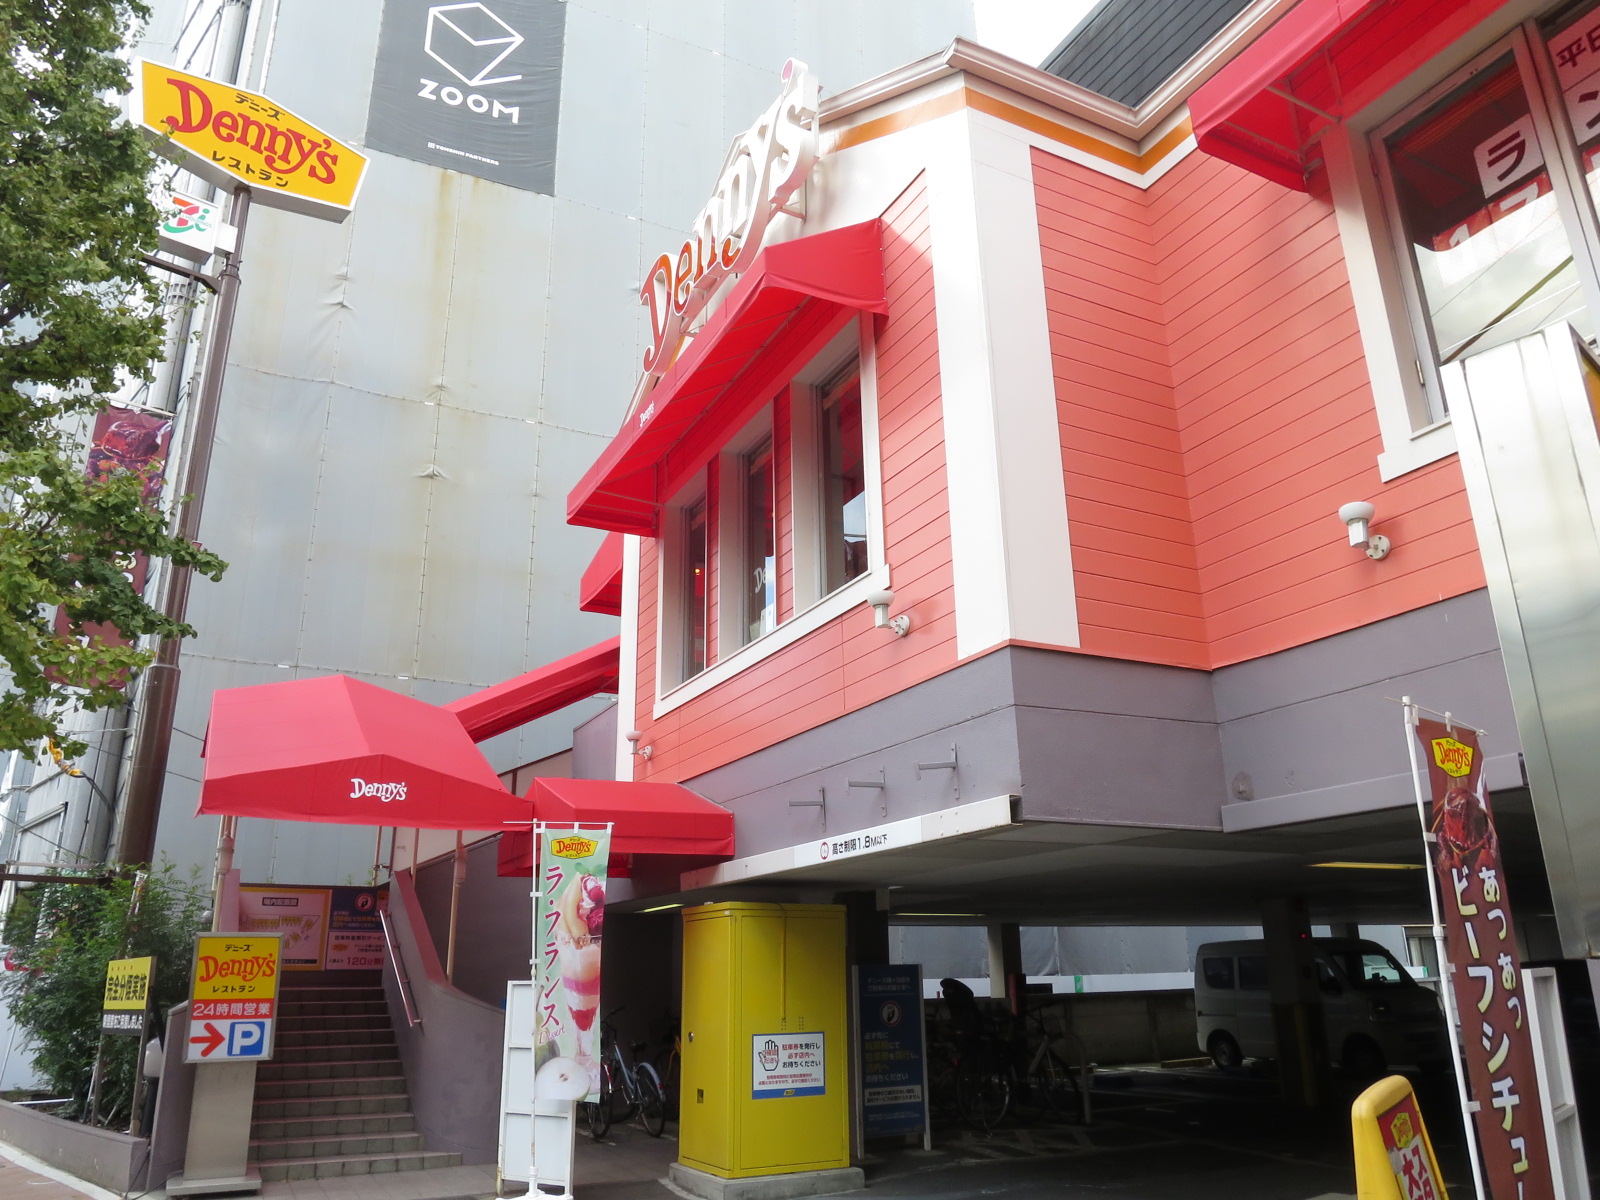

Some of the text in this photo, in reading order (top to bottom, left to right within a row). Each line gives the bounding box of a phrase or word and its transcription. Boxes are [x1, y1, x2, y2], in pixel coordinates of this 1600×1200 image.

[236, 92, 286, 121] デニーズ
[417, 78, 519, 124] ZOOM
[163, 78, 339, 184] Denny's
[212, 151, 289, 187] レストラン
[465, 151, 500, 166] PARTNERS
[640, 57, 816, 377] Denny's
[1435, 742, 1471, 769] Denny's
[350, 778, 407, 802] Denny's
[556, 840, 591, 855] Denny's
[224, 944, 253, 952] デニーズ
[199, 953, 276, 982] Denny's
[212, 985, 256, 993] レストラン
[192, 1003, 271, 1016] 24時間営業
[232, 1022, 261, 1055] P
[782, 1061, 821, 1069] お持ちください
